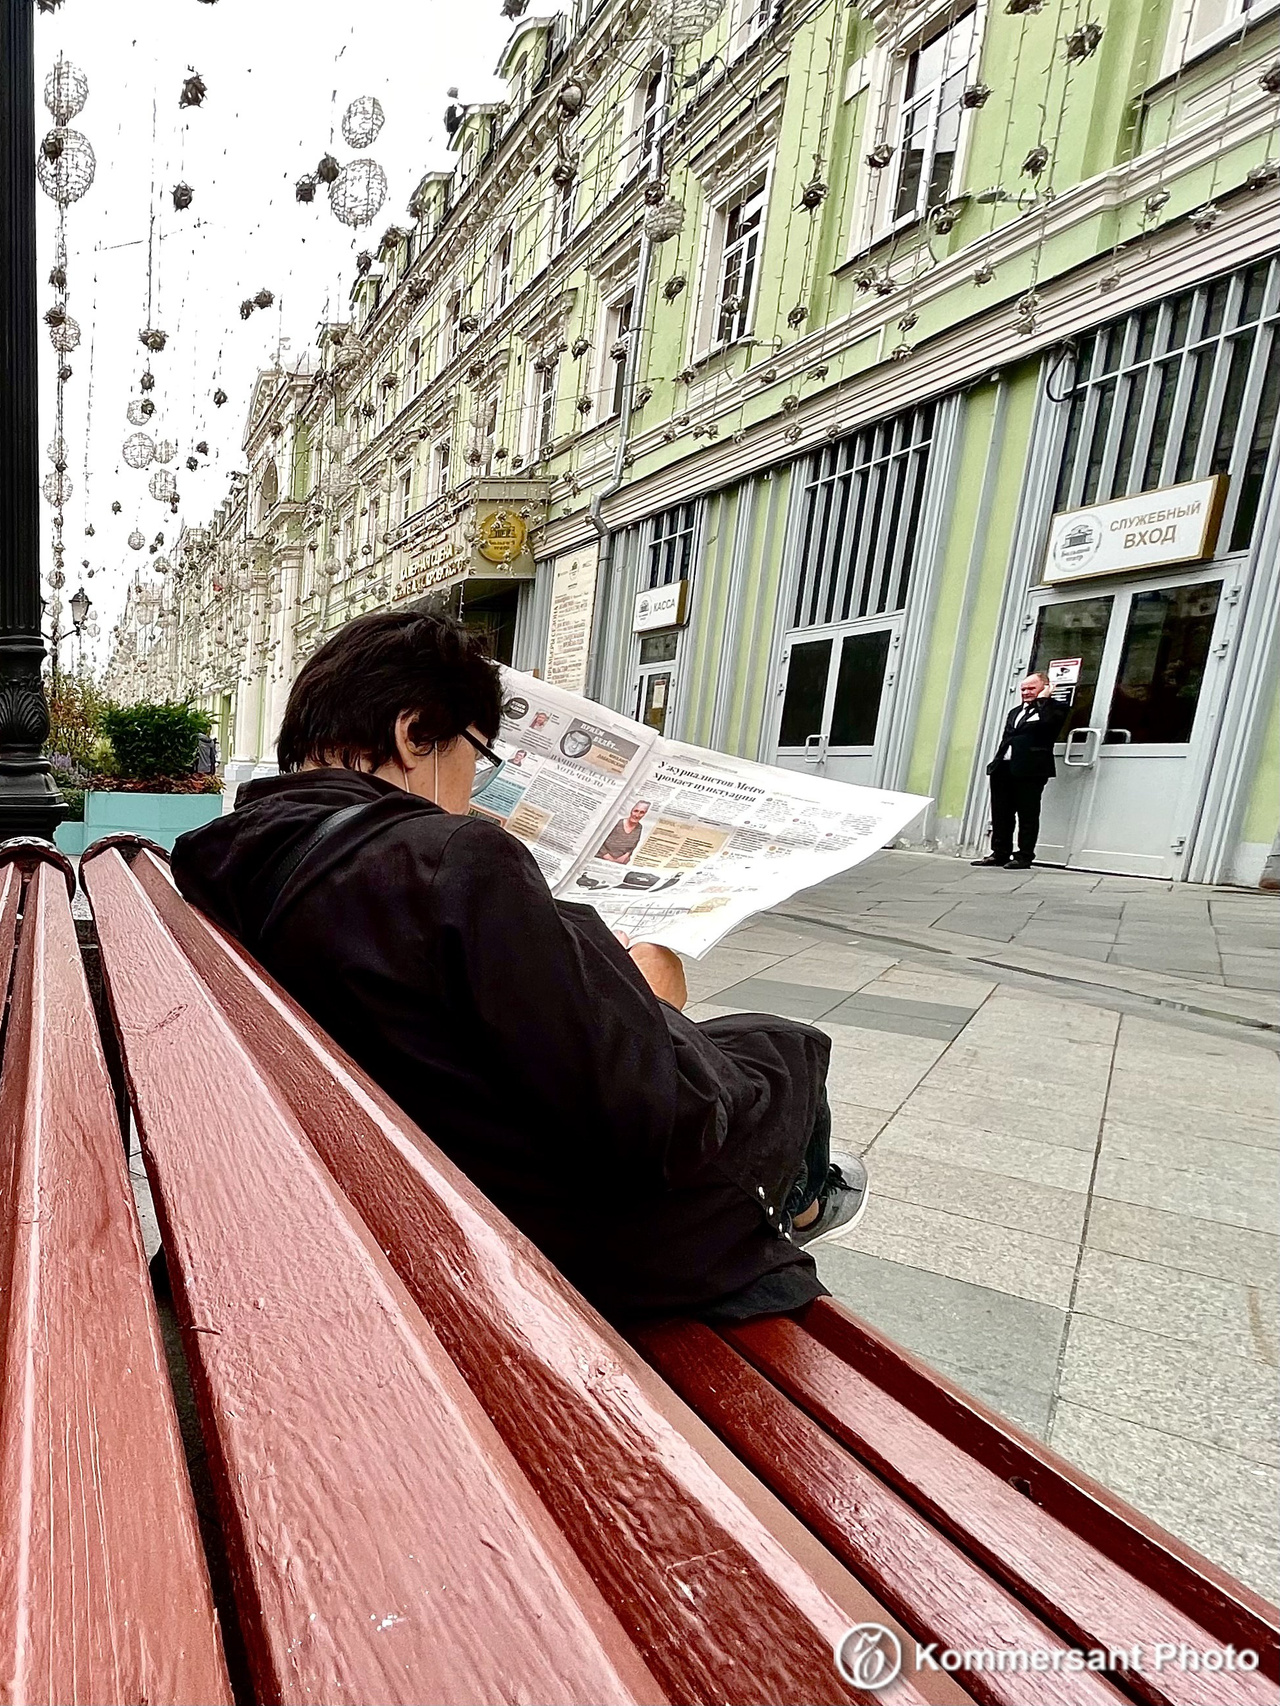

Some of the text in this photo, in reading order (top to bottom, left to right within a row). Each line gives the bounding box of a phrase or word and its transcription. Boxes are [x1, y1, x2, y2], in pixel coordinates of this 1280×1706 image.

[1110, 500, 1202, 532] СЛУЖЕБНЫЙ
[1123, 524, 1177, 549] ВХОД
[653, 598, 676, 612] КАССА
[653, 771, 694, 787] хромает
[693, 783, 757, 803] пунктуация
[666, 763, 734, 787] журналистов
[734, 781, 766, 795] Metro
